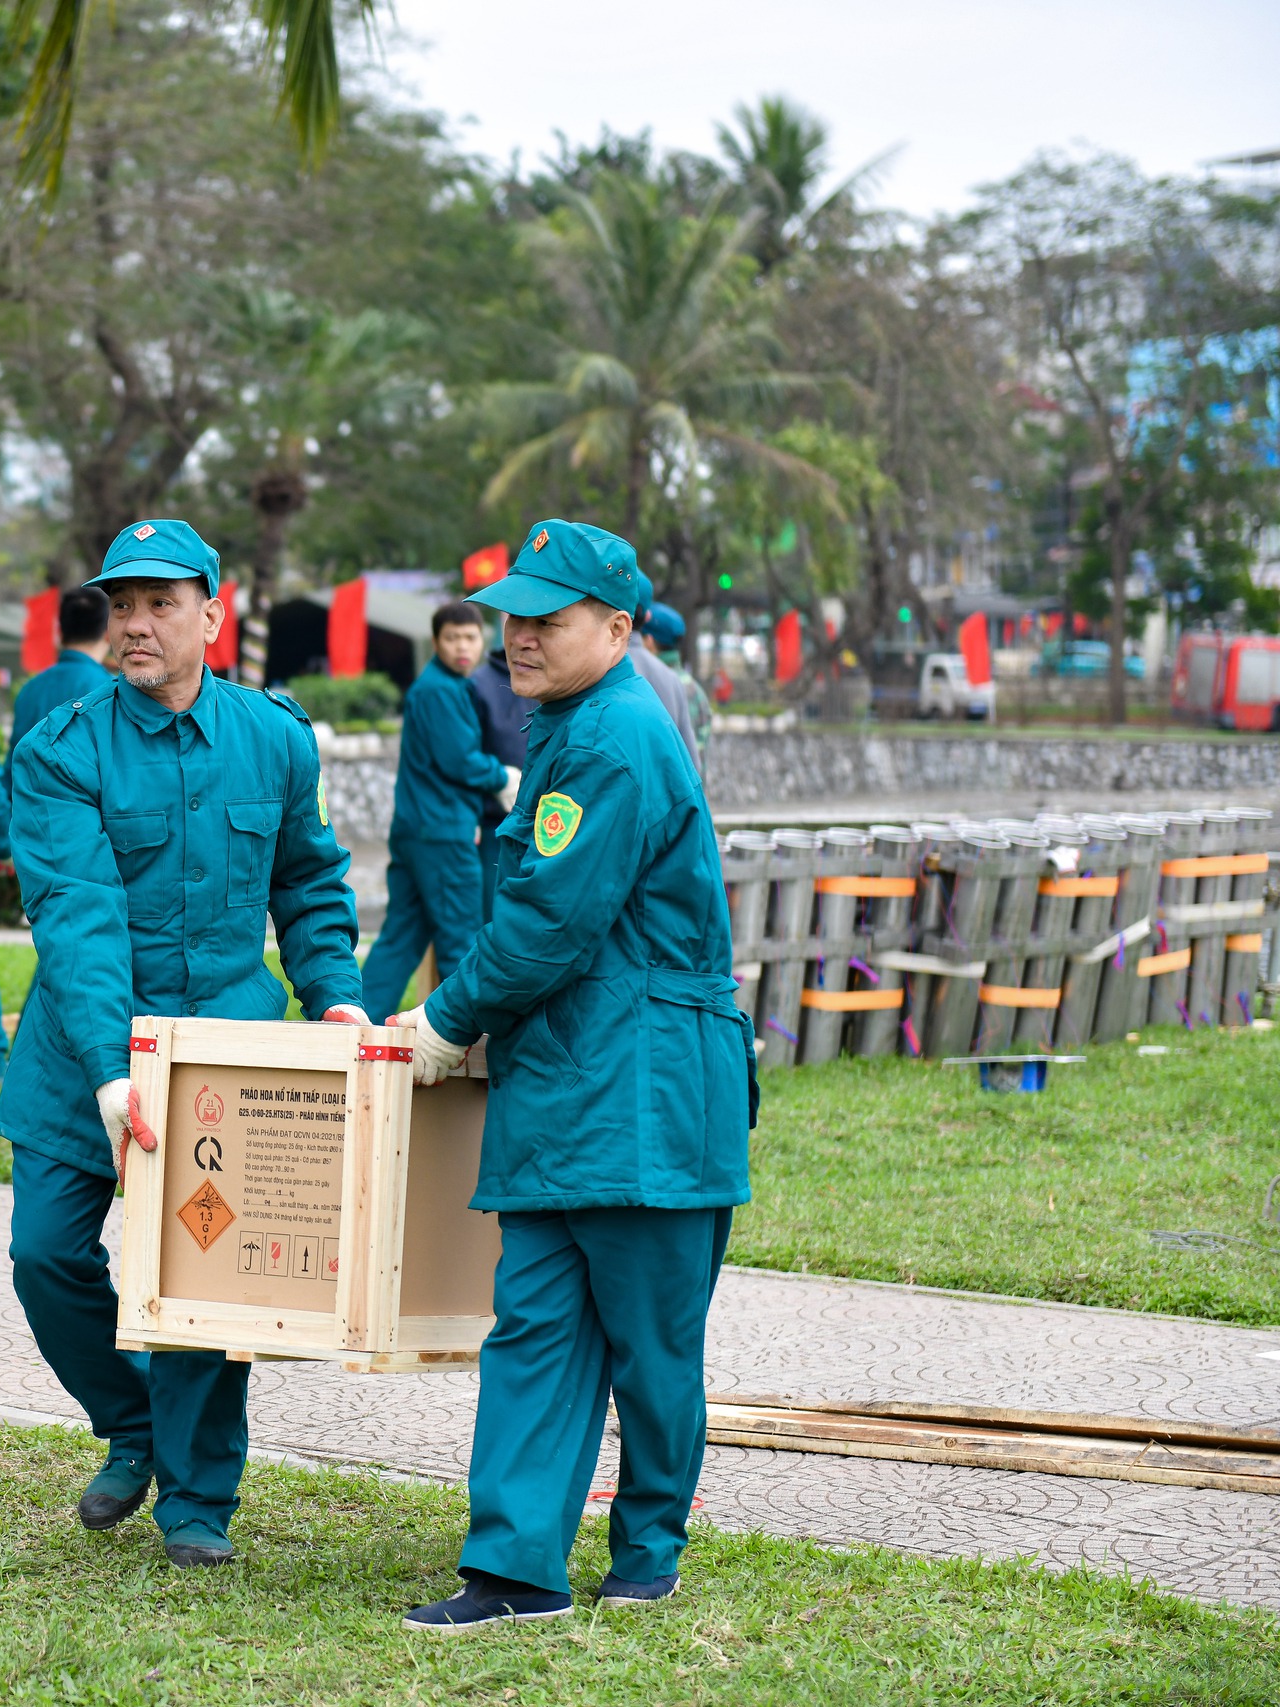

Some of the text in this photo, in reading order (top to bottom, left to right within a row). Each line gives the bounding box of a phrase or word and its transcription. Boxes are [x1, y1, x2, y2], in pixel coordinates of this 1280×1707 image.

[240, 1087, 258, 1100] PHÁO
[260, 1090, 273, 1101] HOA
[303, 1089, 319, 1103] THẤP
[322, 1093, 339, 1106] (LOẠI
[300, 1110, 314, 1120] PHÁO
[200, 1212, 212, 1221] 1.3
[202, 1224, 209, 1233] G
[203, 1235, 207, 1244] 1
